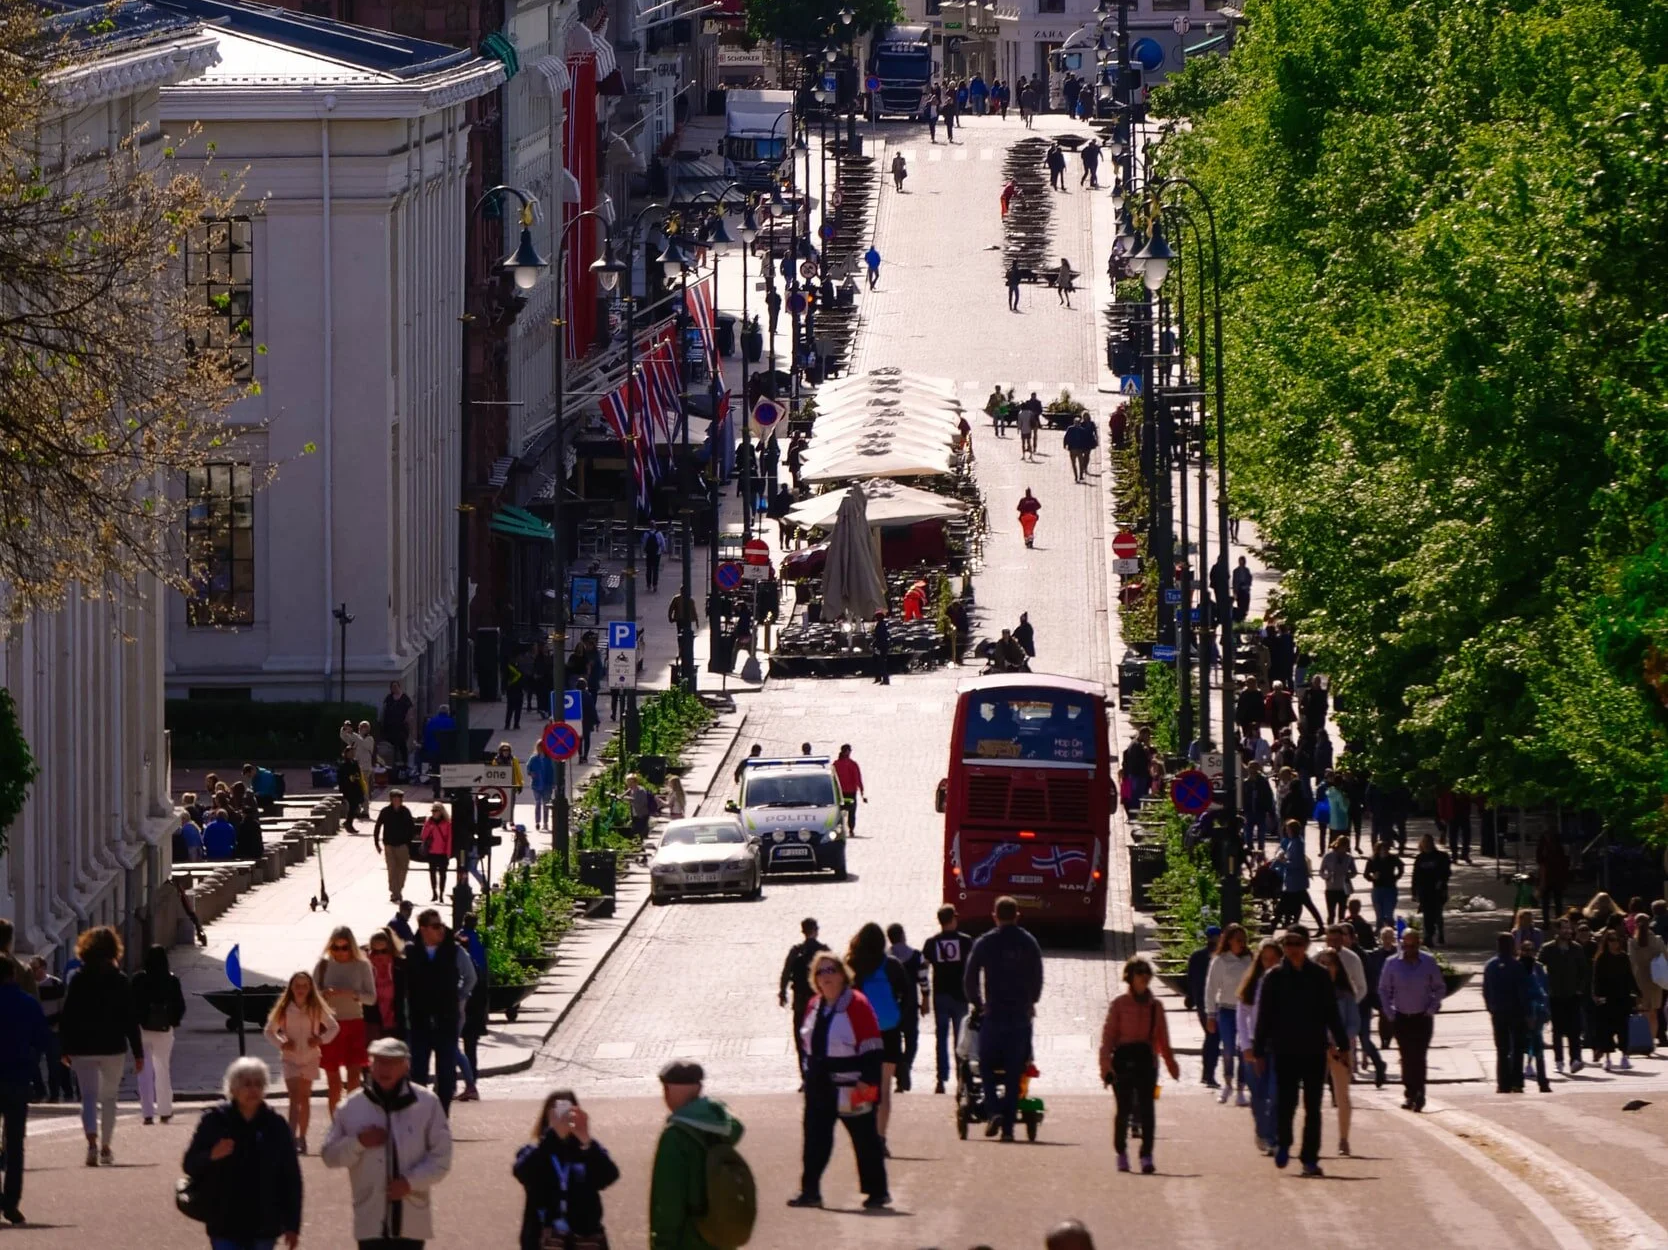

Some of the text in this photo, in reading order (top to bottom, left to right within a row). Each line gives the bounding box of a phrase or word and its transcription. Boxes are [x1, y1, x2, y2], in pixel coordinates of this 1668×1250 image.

[615, 625, 630, 646] P
[765, 813, 817, 823] POLITI
[1058, 882, 1085, 891] MAN
